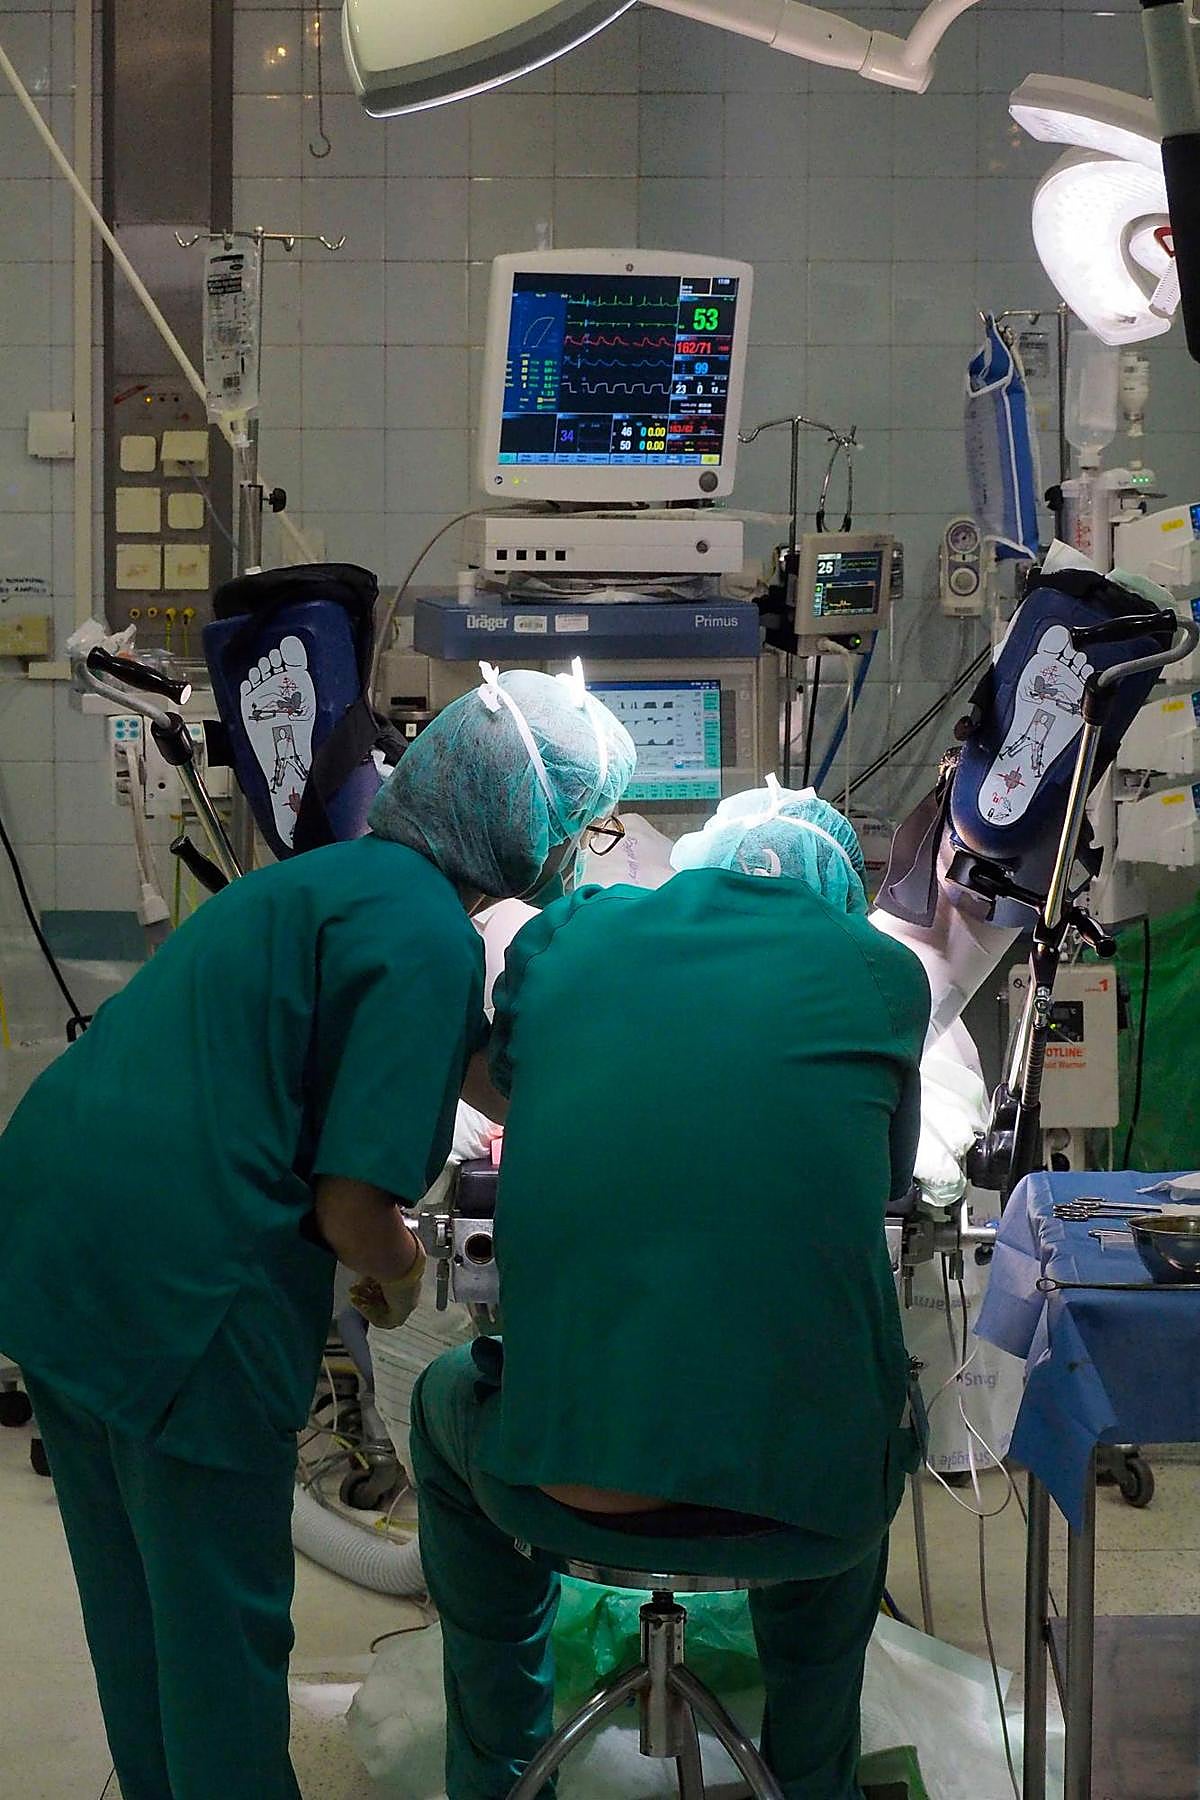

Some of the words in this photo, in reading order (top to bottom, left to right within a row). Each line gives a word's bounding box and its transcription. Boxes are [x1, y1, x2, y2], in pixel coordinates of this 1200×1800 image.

[693, 308, 719, 331] 53
[677, 342, 711, 353] 162/71
[695, 362, 709, 374] 99
[675, 385, 687, 394] 23
[696, 385, 703, 394] 0
[560, 430, 574, 442] 34
[620, 427, 632, 437] 46
[640, 427, 647, 437] 0
[648, 427, 666, 437] 0.00
[620, 441, 631, 451] 50
[639, 441, 646, 450] 0
[646, 441, 665, 450] 0.00
[817, 561, 834, 574] 25
[466, 614, 508, 631] Dräger
[695, 614, 738, 627] Primus
[1044, 1048, 1083, 1057] OTLINE
